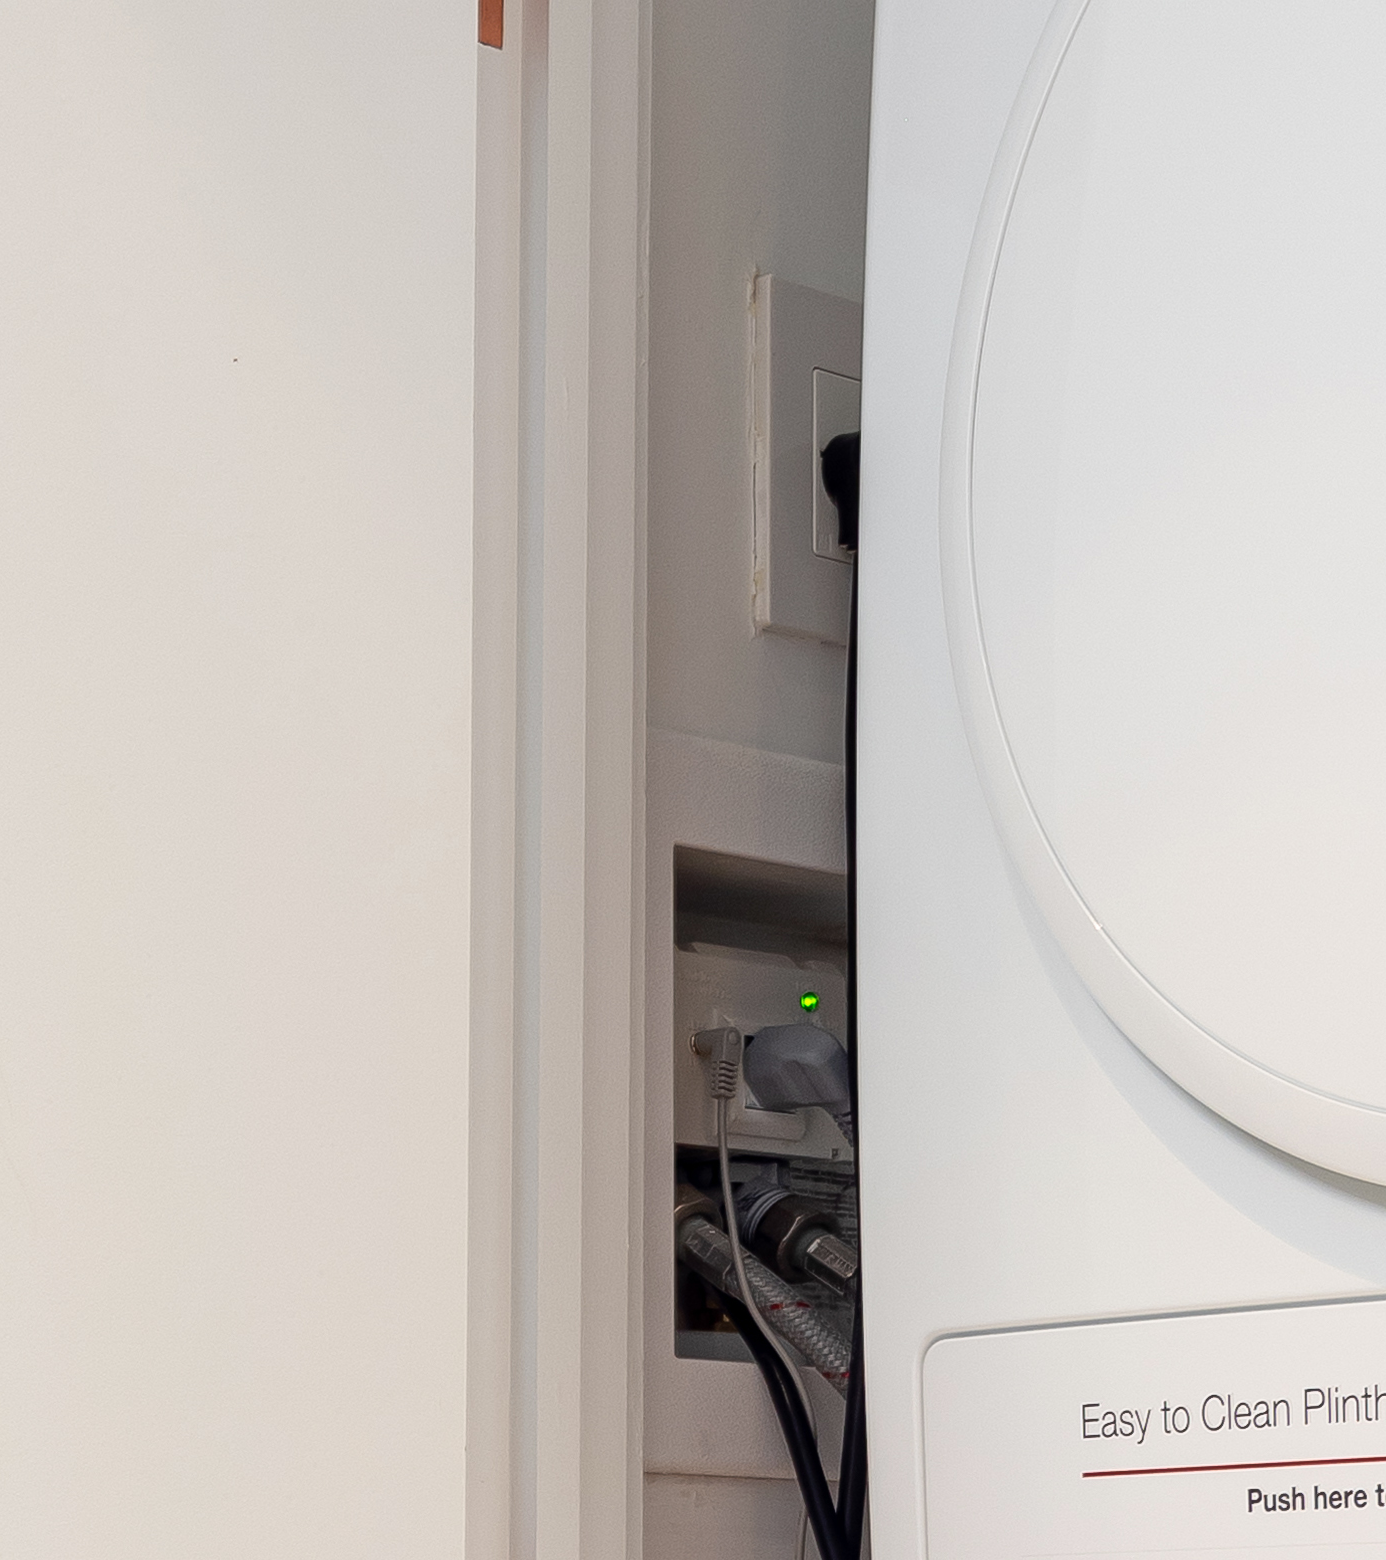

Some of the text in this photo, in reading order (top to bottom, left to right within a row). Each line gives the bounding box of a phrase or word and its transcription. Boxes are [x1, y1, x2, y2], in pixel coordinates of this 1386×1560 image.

[1082, 1403, 1150, 1444] Easy
[1161, 1403, 1190, 1434] to
[1201, 1395, 1291, 1432] Clean
[1247, 1486, 1306, 1513] Push
[1313, 1486, 1367, 1510] here
